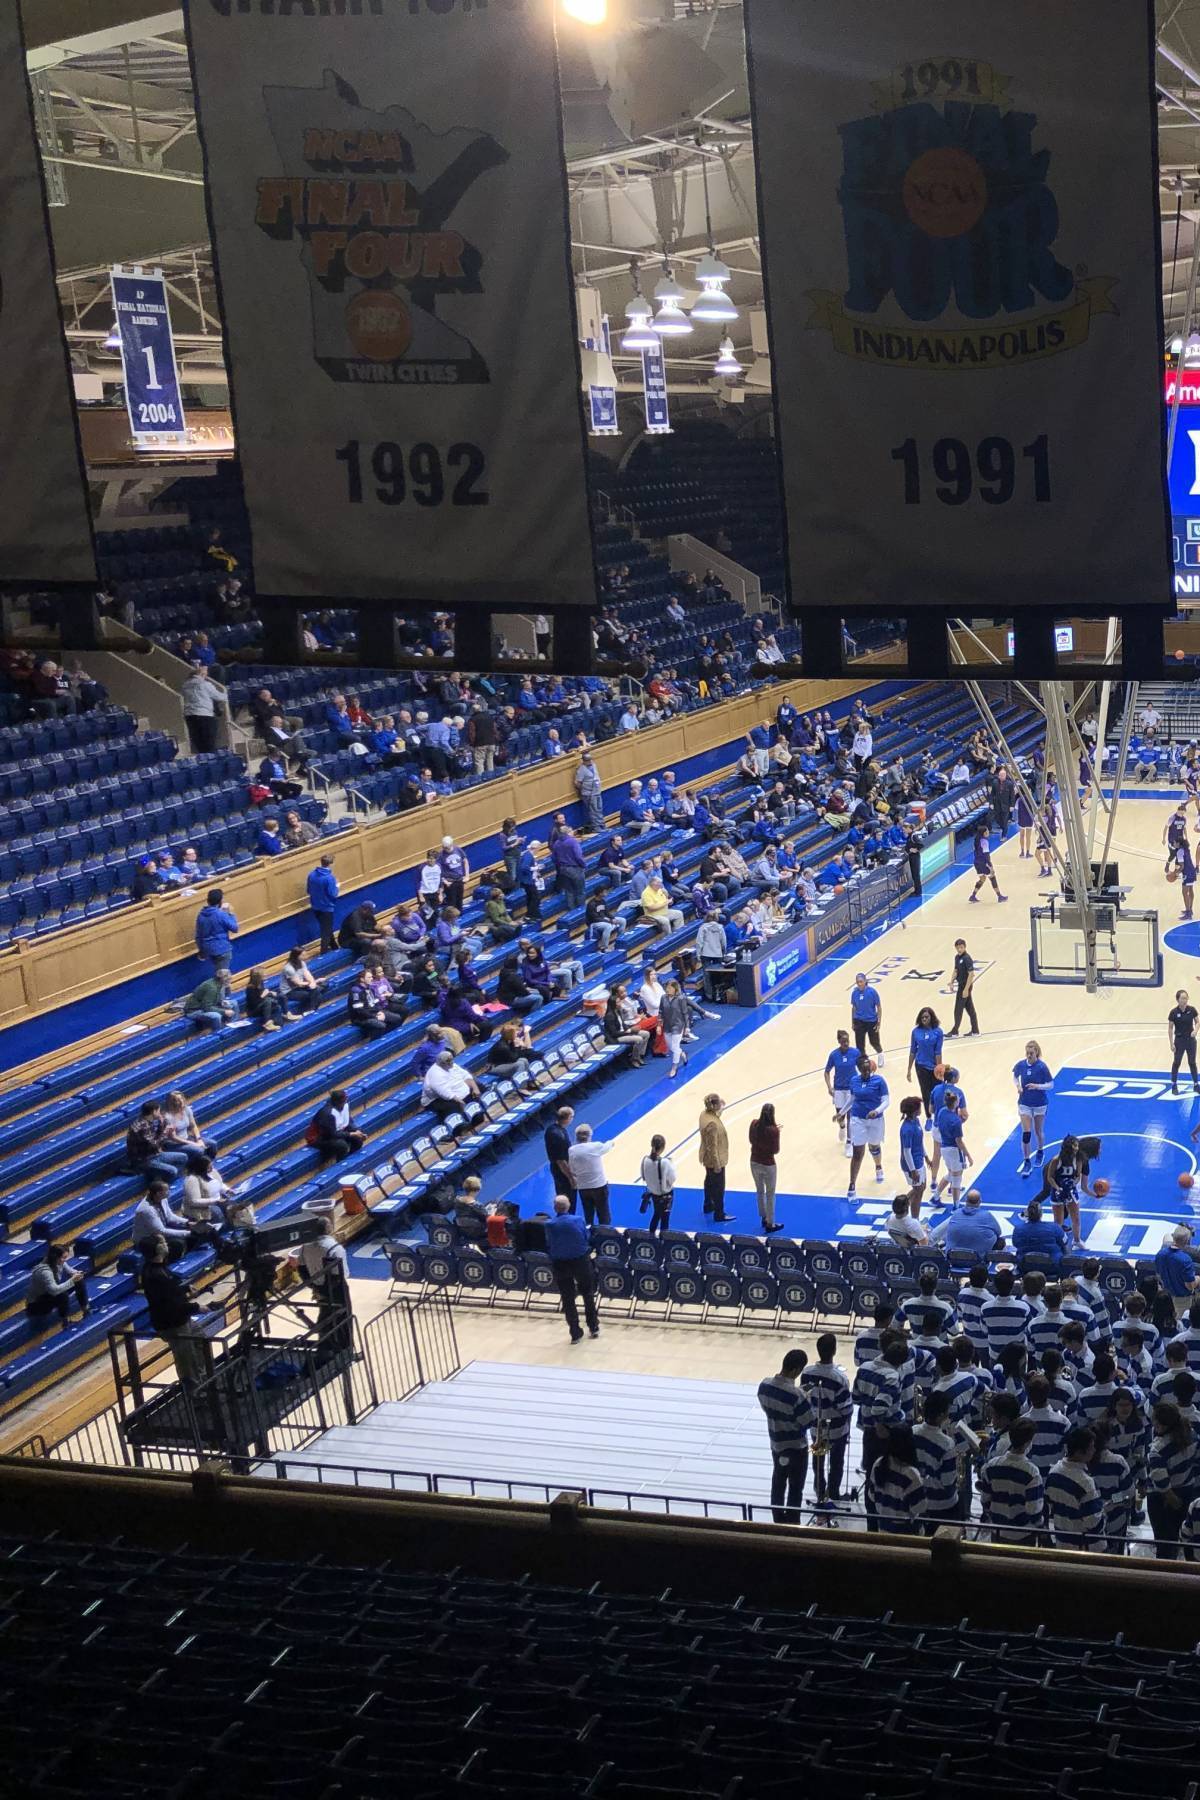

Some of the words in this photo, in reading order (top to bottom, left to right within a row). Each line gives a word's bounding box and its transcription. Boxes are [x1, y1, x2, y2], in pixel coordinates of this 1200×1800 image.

[900, 61, 981, 99] 1991
[254, 177, 420, 225] FINAL
[309, 231, 465, 280] FOUR
[852, 319, 1066, 364] INDIANAPOLIS
[141, 345, 162, 390] 1
[346, 363, 395, 382] TWIN
[398, 363, 458, 383] CITIES
[139, 403, 177, 423] 2004
[335, 439, 490, 507] 1992
[890, 433, 1052, 506] 1991
